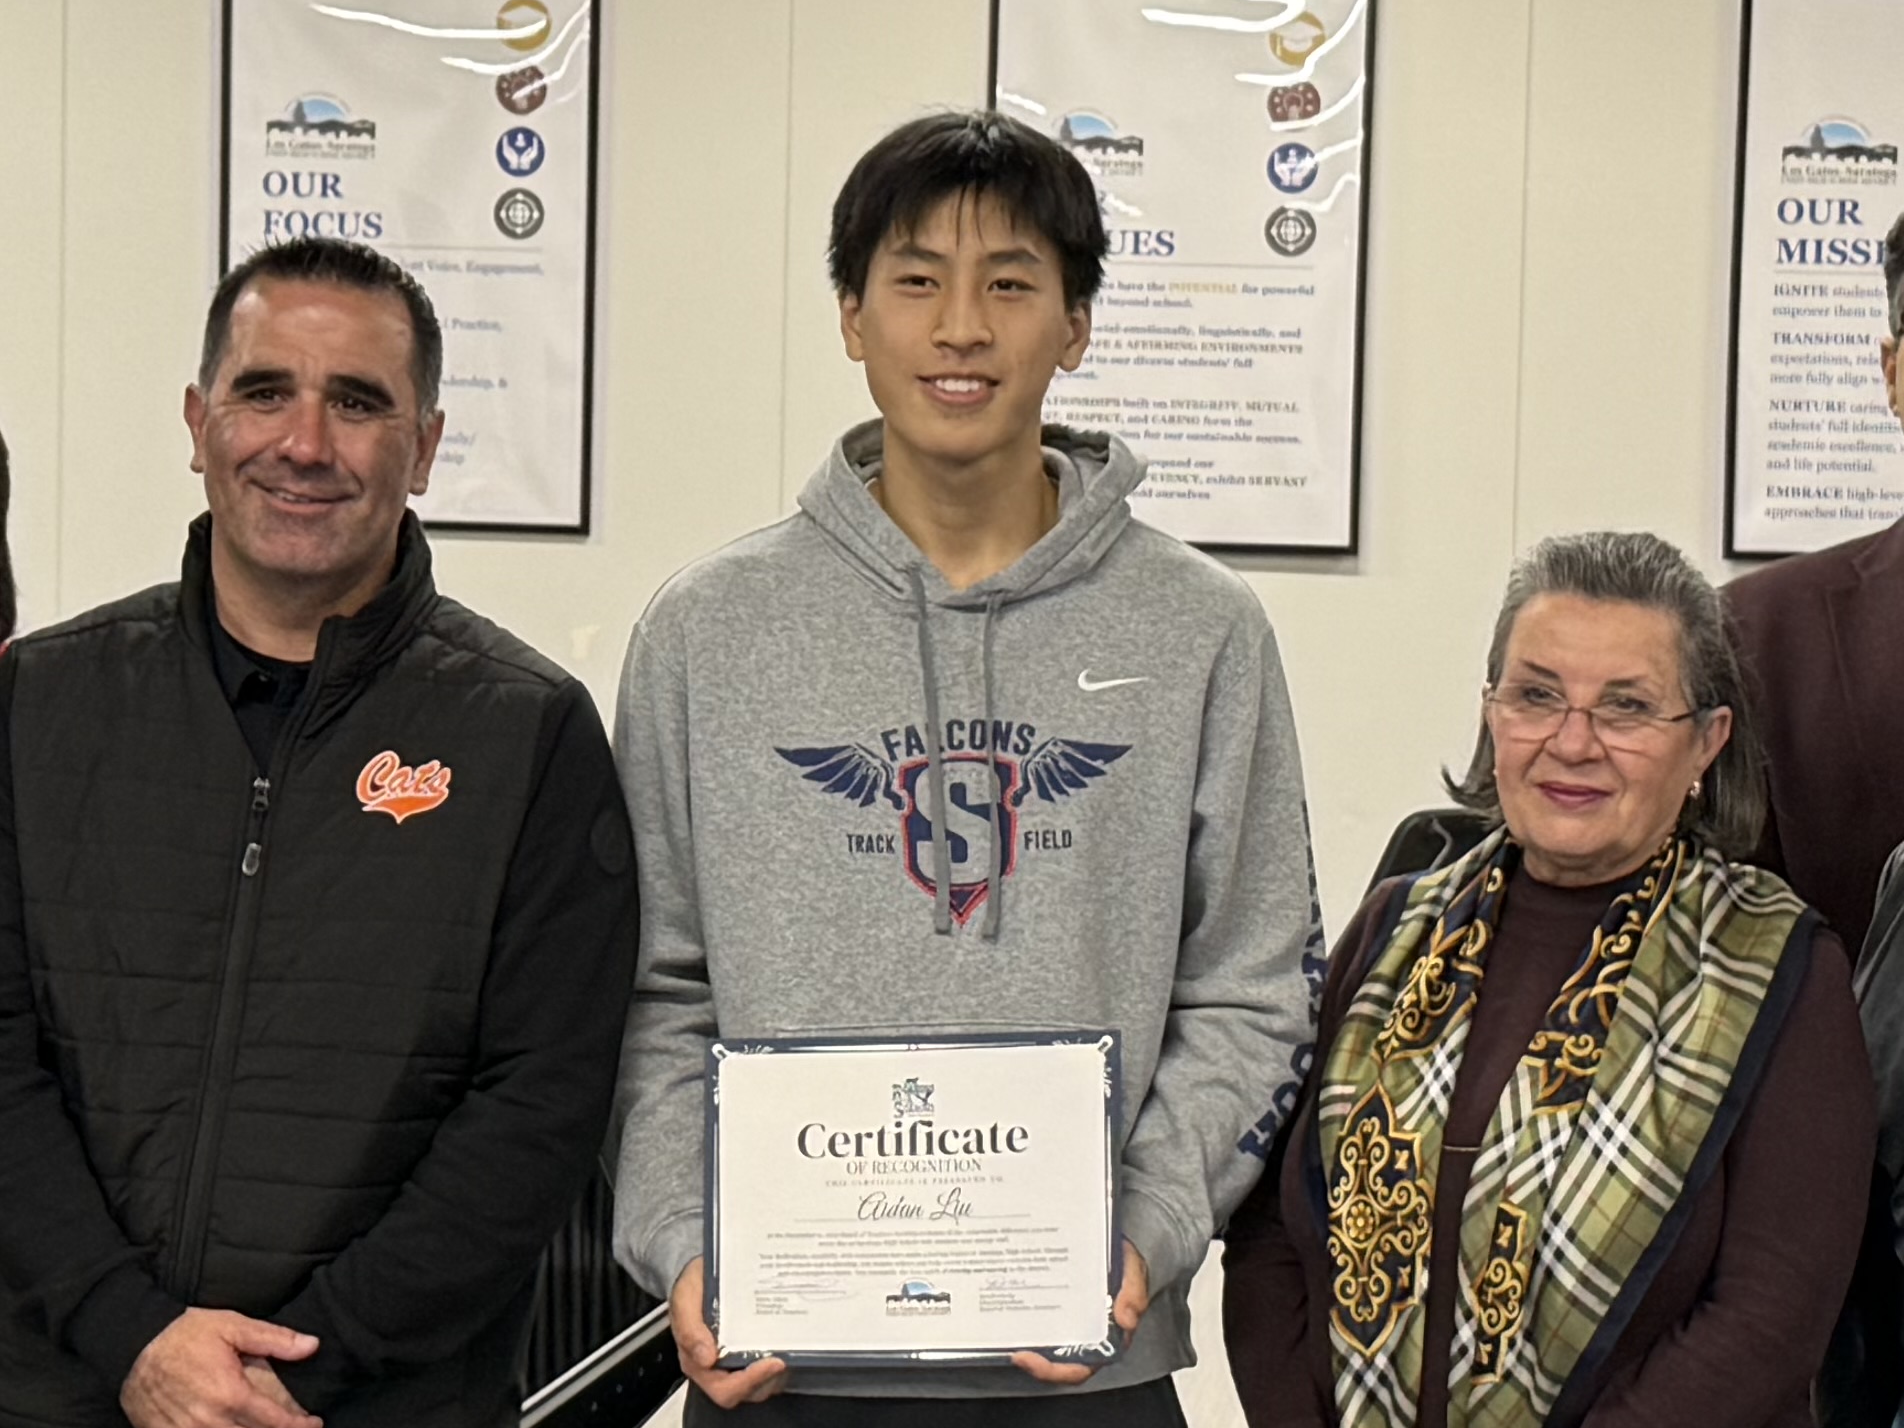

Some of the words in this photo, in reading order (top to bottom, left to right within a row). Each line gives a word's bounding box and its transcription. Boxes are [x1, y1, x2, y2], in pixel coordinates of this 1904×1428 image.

[262, 170, 343, 198] OUR
[1777, 198, 1863, 225] OUR
[264, 209, 384, 240] FOCUS
[1106, 230, 1175, 256] UES
[1776, 238, 1886, 266] MISSI
[1834, 305, 1866, 317] them
[1870, 306, 1882, 317] to
[1773, 332, 1870, 345] TRANSFORM
[1769, 399, 1846, 413] NURTURE
[1766, 458, 1791, 470] and
[1794, 457, 1813, 471] life
[1766, 485, 1844, 500] EMBRACE
[1840, 506, 1864, 520] that
[880, 718, 1037, 762] FACONS
[356, 750, 452, 816] Cats
[846, 834, 896, 854] TRACK
[1024, 829, 1073, 850] FIELD
[797, 1120, 1029, 1160] Certificate
[846, 1160, 867, 1175] OF
[872, 1157, 983, 1174] RECOGNITION
[857, 1190, 925, 1221] Aidan
